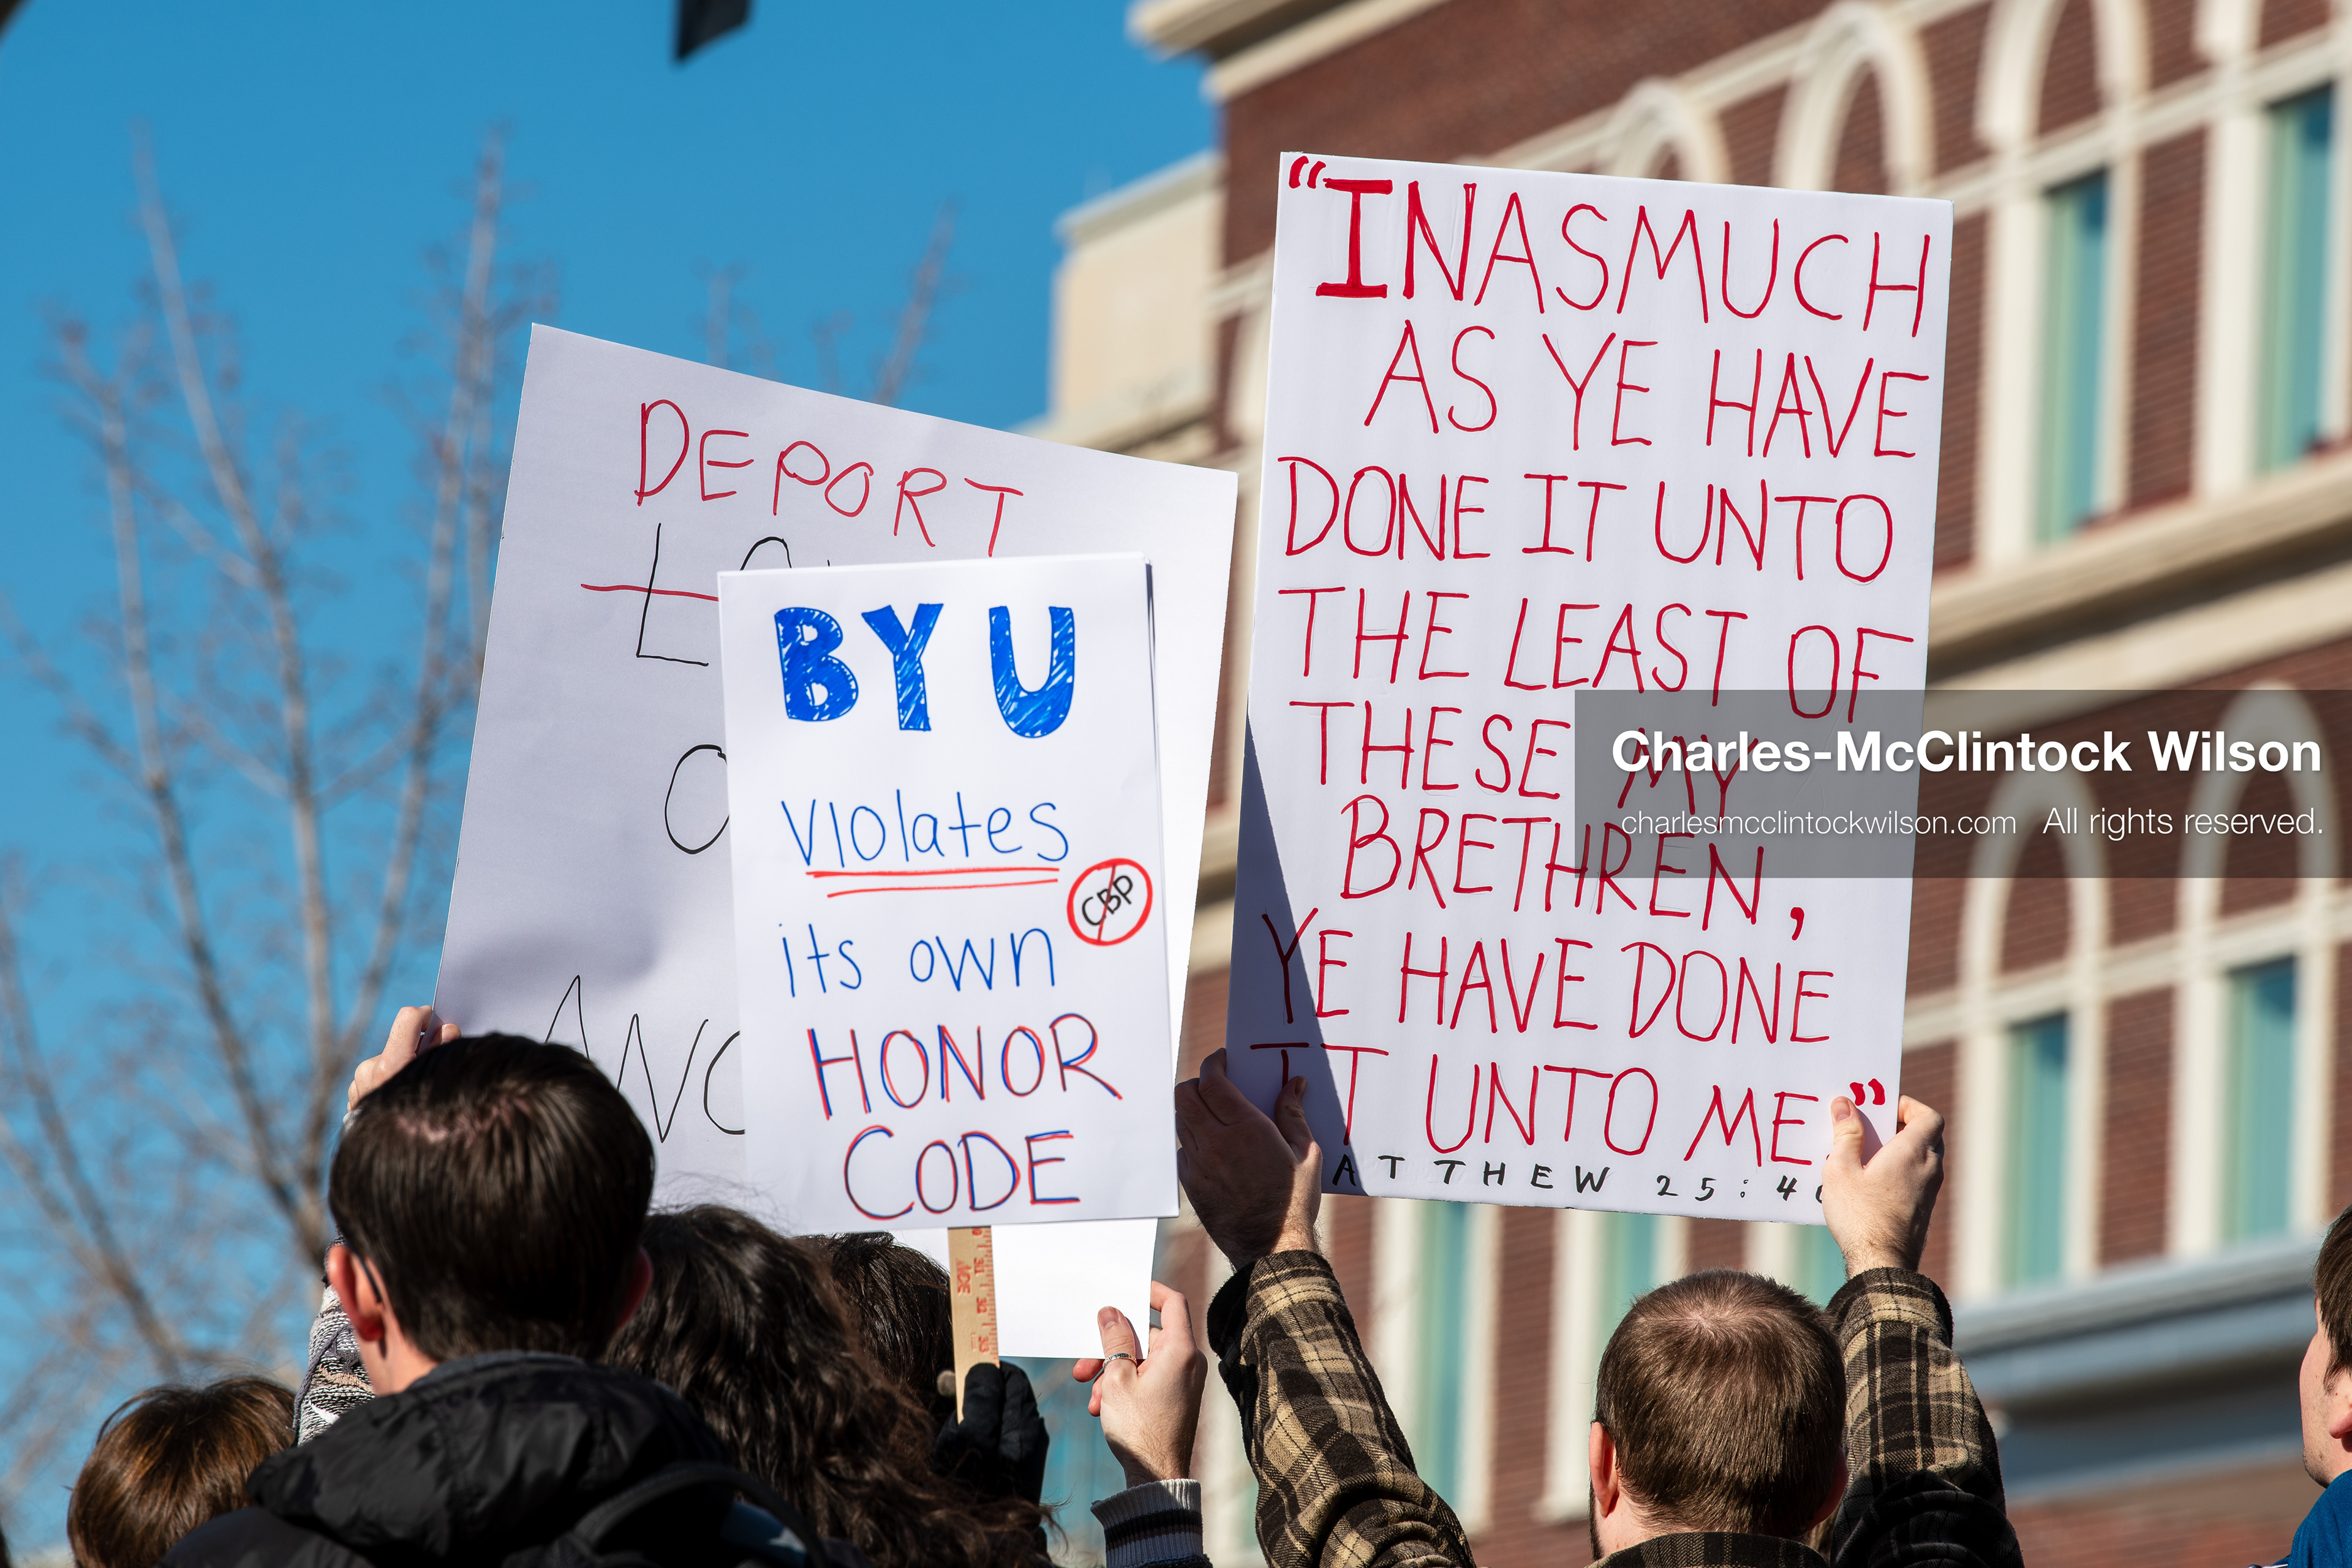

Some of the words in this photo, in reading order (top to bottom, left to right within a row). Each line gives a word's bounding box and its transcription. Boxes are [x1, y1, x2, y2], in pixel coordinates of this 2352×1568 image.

[1289, 156, 1930, 337] “INASMUCH
[1364, 319, 1497, 434] AS
[1542, 333, 1658, 451] YE
[1706, 349, 1929, 458] HAVE
[635, 399, 1023, 557] DEPORT
[1278, 456, 1490, 561] DONE
[1522, 473, 1627, 562] IT
[1655, 479, 1893, 582] UNTO
[1278, 587, 1469, 684] THE
[1504, 598, 1748, 706] LEAST
[1788, 625, 1914, 723] OF
[1289, 701, 1570, 799] THESE
[1618, 728, 1759, 830] MY
[1082, 875, 1133, 926] CBP
[1340, 794, 1804, 940] BRETHREN,
[778, 924, 861, 997] its
[910, 928, 1055, 992] own
[1261, 908, 1353, 1025] YE
[1399, 932, 1598, 1033] HAVE
[1621, 942, 1834, 1044] DONE
[806, 1013, 1123, 1120] HONOR
[1426, 1054, 1658, 1156] UNTO
[843, 1125, 1081, 1221] CODE
[1332, 1154, 1610, 1193] ATTHEW
[957, 1259, 971, 1295] ACE
[974, 1258, 985, 1275] 31
[976, 1297, 987, 1314] 32
